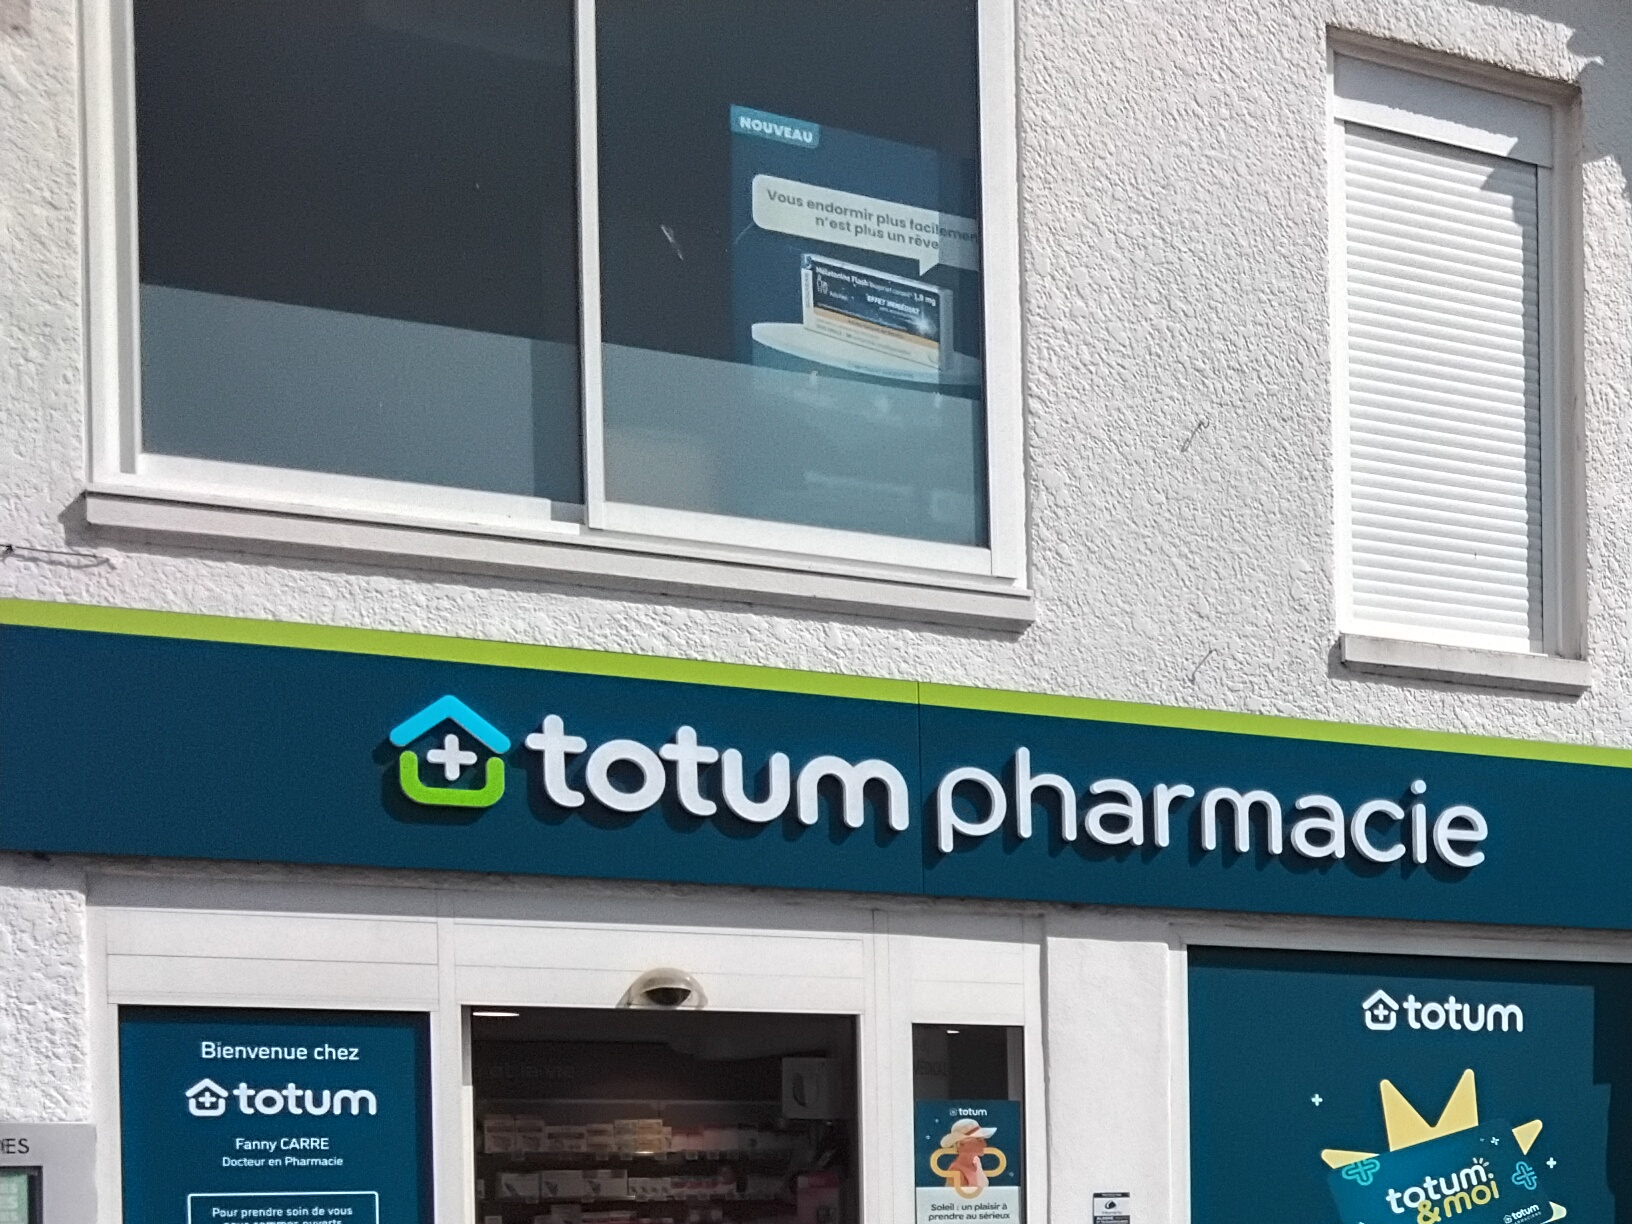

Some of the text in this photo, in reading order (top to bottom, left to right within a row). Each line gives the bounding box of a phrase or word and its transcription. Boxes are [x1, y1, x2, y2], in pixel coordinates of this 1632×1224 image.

[739, 116, 813, 143] NOUVEAU
[767, 188, 803, 208] Vous
[807, 198, 873, 222] endormir
[876, 213, 906, 232] plus
[815, 217, 939, 250] n'est plus un rêve
[525, 714, 1489, 869] totum pharmacie
[1403, 993, 1524, 1032] totum
[201, 1041, 360, 1061] Bienvenue chez
[233, 1083, 377, 1116] totum
[958, 1107, 988, 1116] totum
[0, 1138, 30, 1154] ES
[235, 1138, 330, 1152] Fanny CARRE
[222, 1156, 343, 1167] Docteur en Pharmacie
[1386, 1164, 1488, 1214] totum
[212, 1206, 353, 1219] Pour prendre soin de vous
[931, 1202, 954, 1211] Soleil
[974, 1202, 1000, 1212] plaisir
[1511, 1203, 1540, 1220] totum
[928, 1213, 964, 1222] prendre
[979, 1211, 1010, 1220] sérieux
